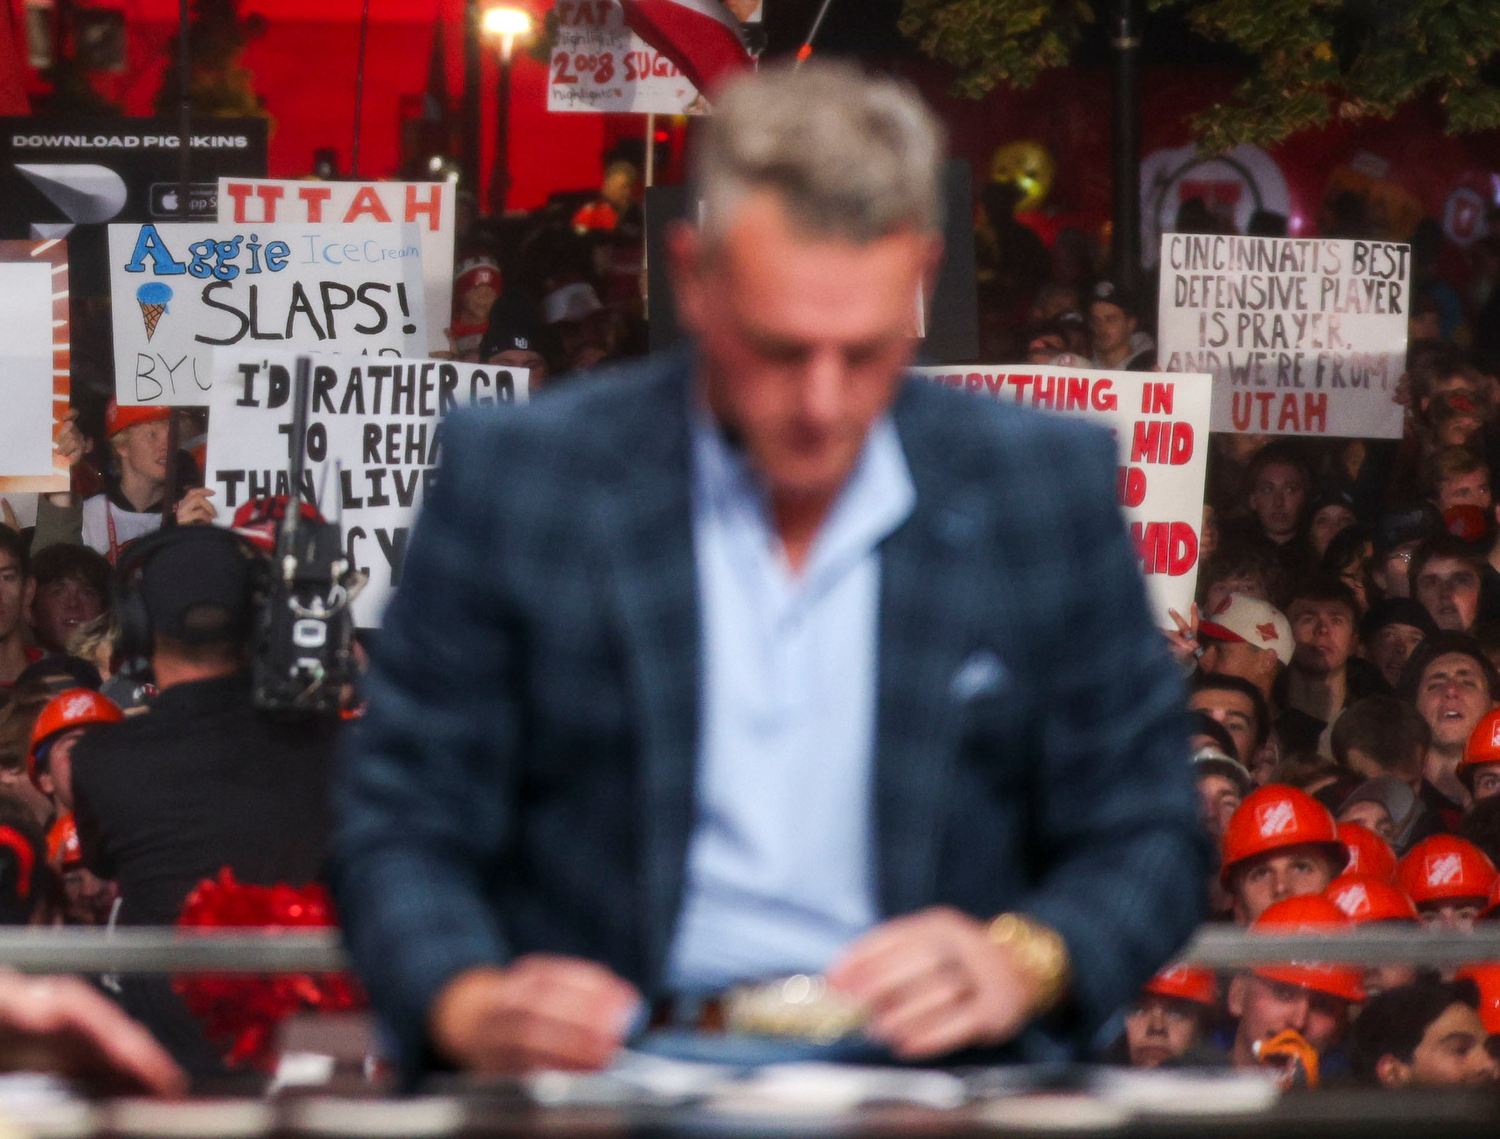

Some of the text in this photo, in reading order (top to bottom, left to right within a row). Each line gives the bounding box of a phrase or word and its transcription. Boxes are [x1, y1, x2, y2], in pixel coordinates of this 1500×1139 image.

[553, 51, 615, 85] 2008
[12, 134, 140, 148] DOWNLOAD
[227, 183, 443, 232] UTAH
[124, 224, 292, 281] Aggie
[1169, 235, 1411, 281] CINCINNATI'S BEST
[195, 279, 418, 346] SLAPS!
[1174, 273, 1404, 316] DEFENSIVE PLAYER
[1198, 311, 1230, 348] IS
[235, 358, 292, 410] I'D
[312, 362, 460, 418] RATHER
[1165, 350, 1390, 391] AND WE'RE FROM
[1141, 381, 1176, 415] IN
[1231, 389, 1329, 433] UTAH
[1131, 420, 1195, 466] MID
